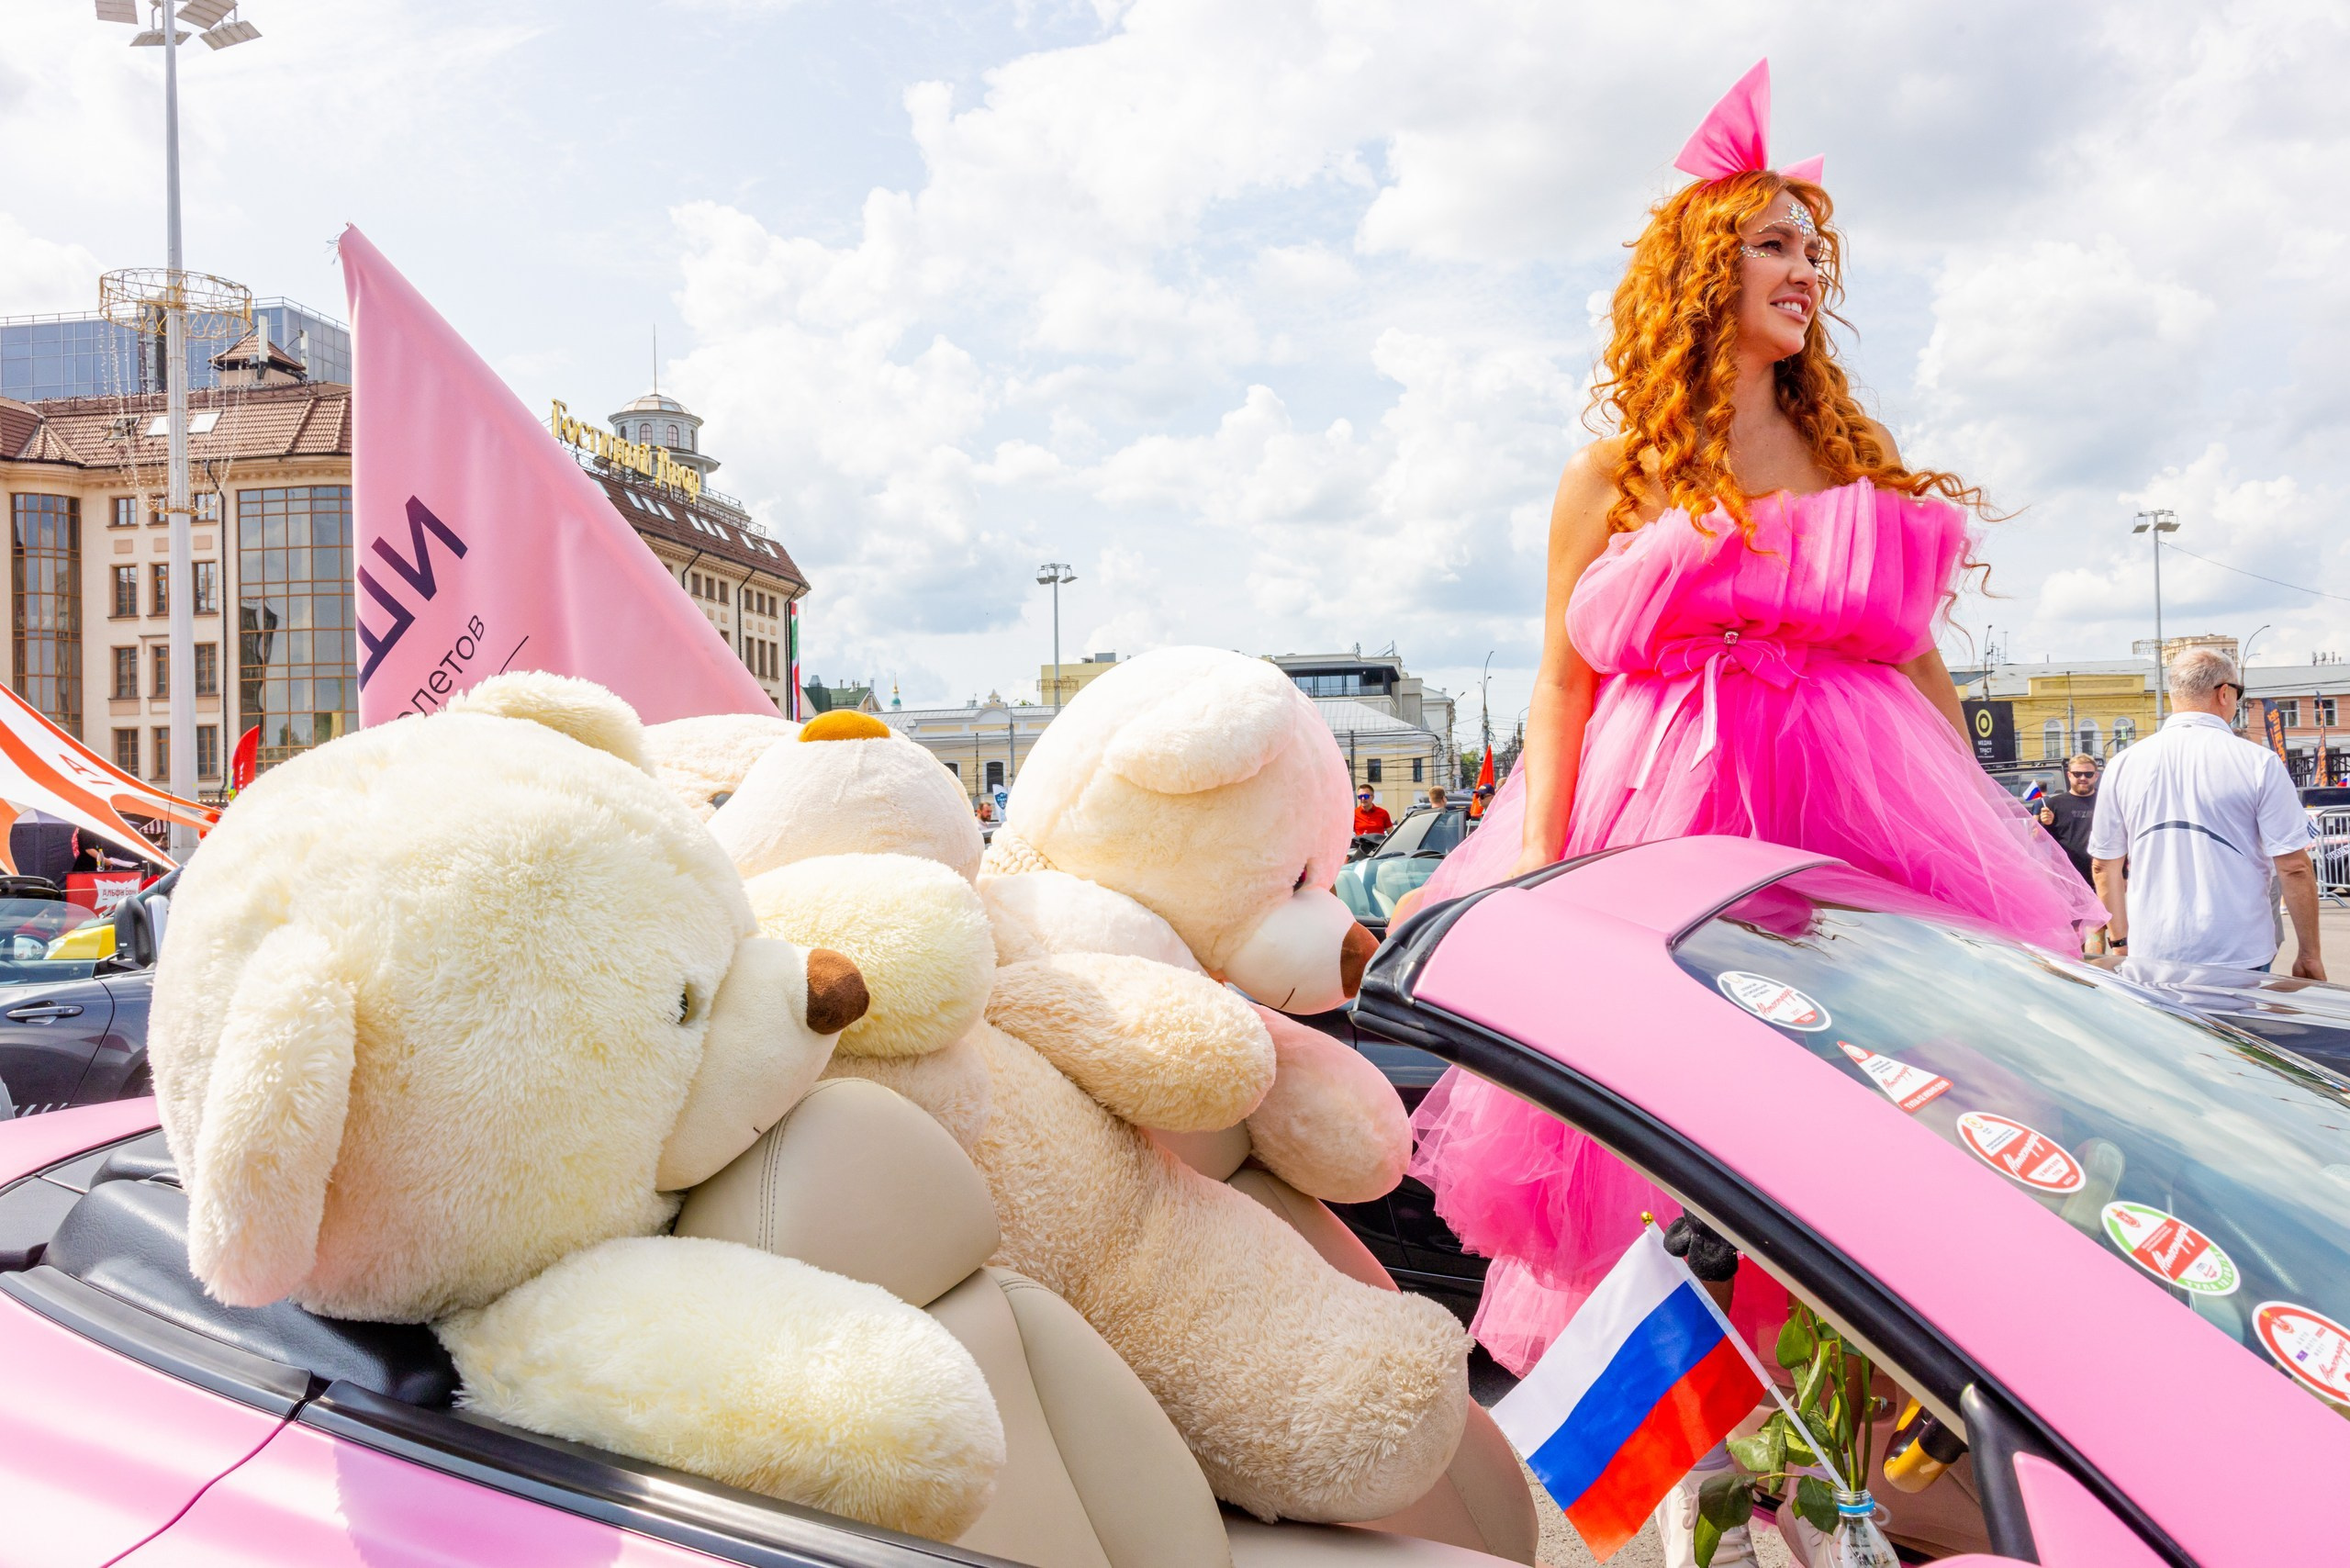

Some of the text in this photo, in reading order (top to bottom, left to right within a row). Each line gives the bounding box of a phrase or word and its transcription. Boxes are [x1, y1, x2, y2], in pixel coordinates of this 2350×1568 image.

[552, 398, 701, 503] Гостиный Двор
[1756, 988, 1796, 1020] Автострада
[2002, 1132, 2044, 1180] Автострада
[2151, 1225, 2196, 1282] Автострада
